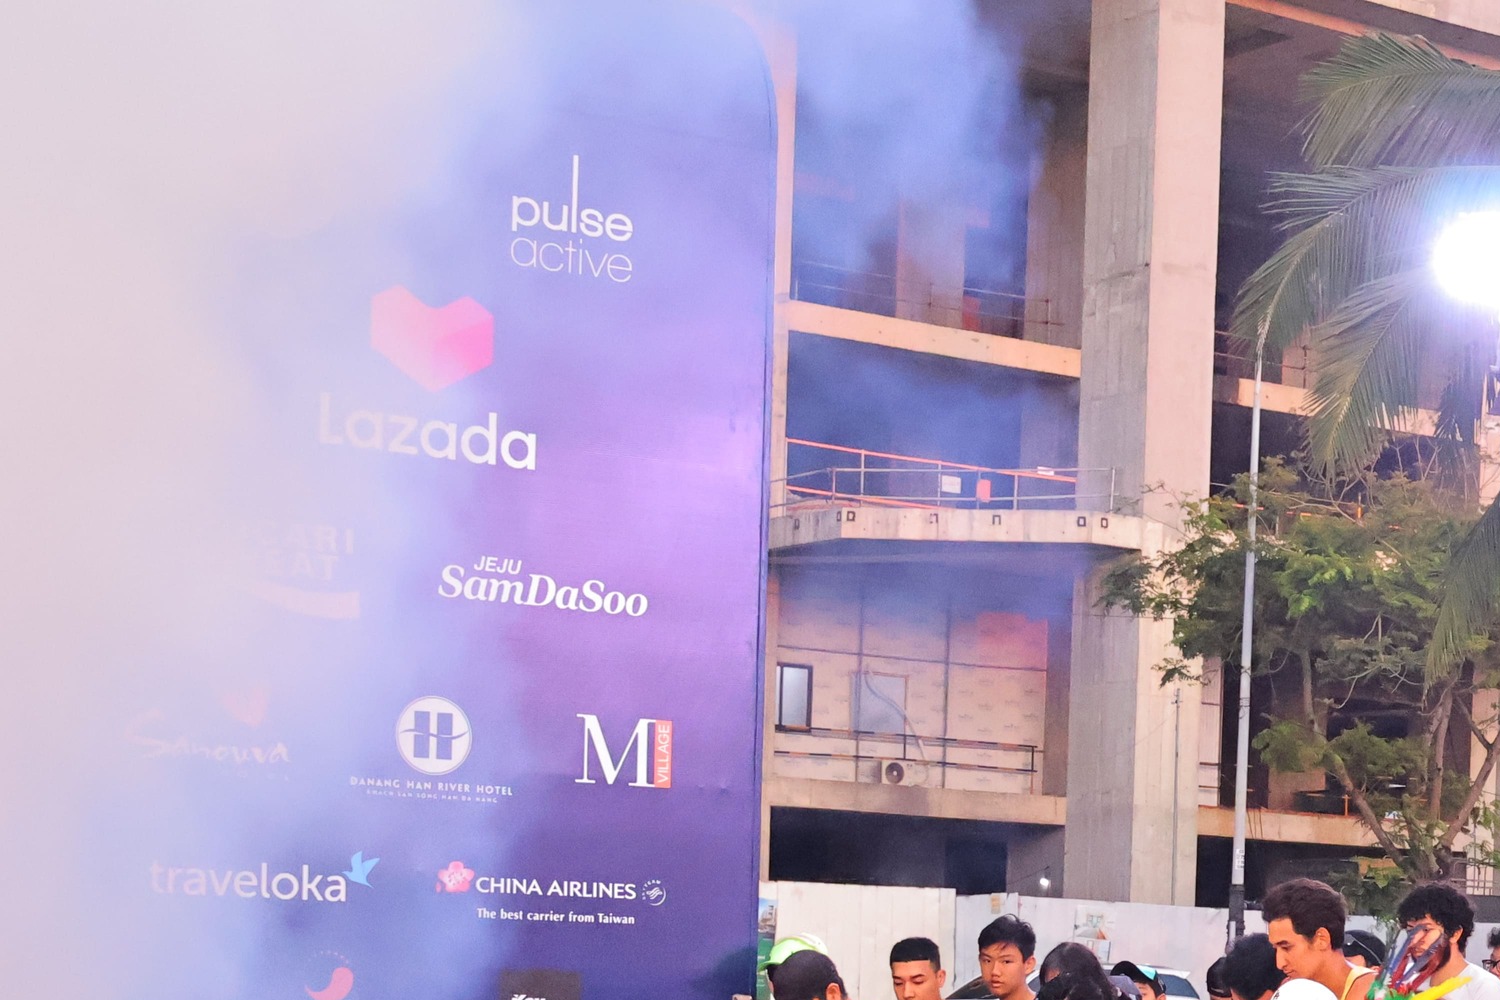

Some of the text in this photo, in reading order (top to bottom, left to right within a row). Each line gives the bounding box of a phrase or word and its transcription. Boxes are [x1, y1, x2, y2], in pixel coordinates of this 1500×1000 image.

[510, 154, 634, 242] pulse
[510, 237, 633, 283] active
[318, 392, 537, 471] Lazada
[473, 555, 523, 575] JEJU
[437, 564, 649, 617] SamDaSoo
[574, 712, 656, 788] M
[656, 723, 671, 784] VILLAGE
[349, 775, 513, 796] DANANG HAN RIVER HOTEL
[150, 861, 347, 903] traveloka
[475, 876, 636, 900] CHINA AIRLINES
[477, 907, 635, 925] The best carrier from Taiwan
